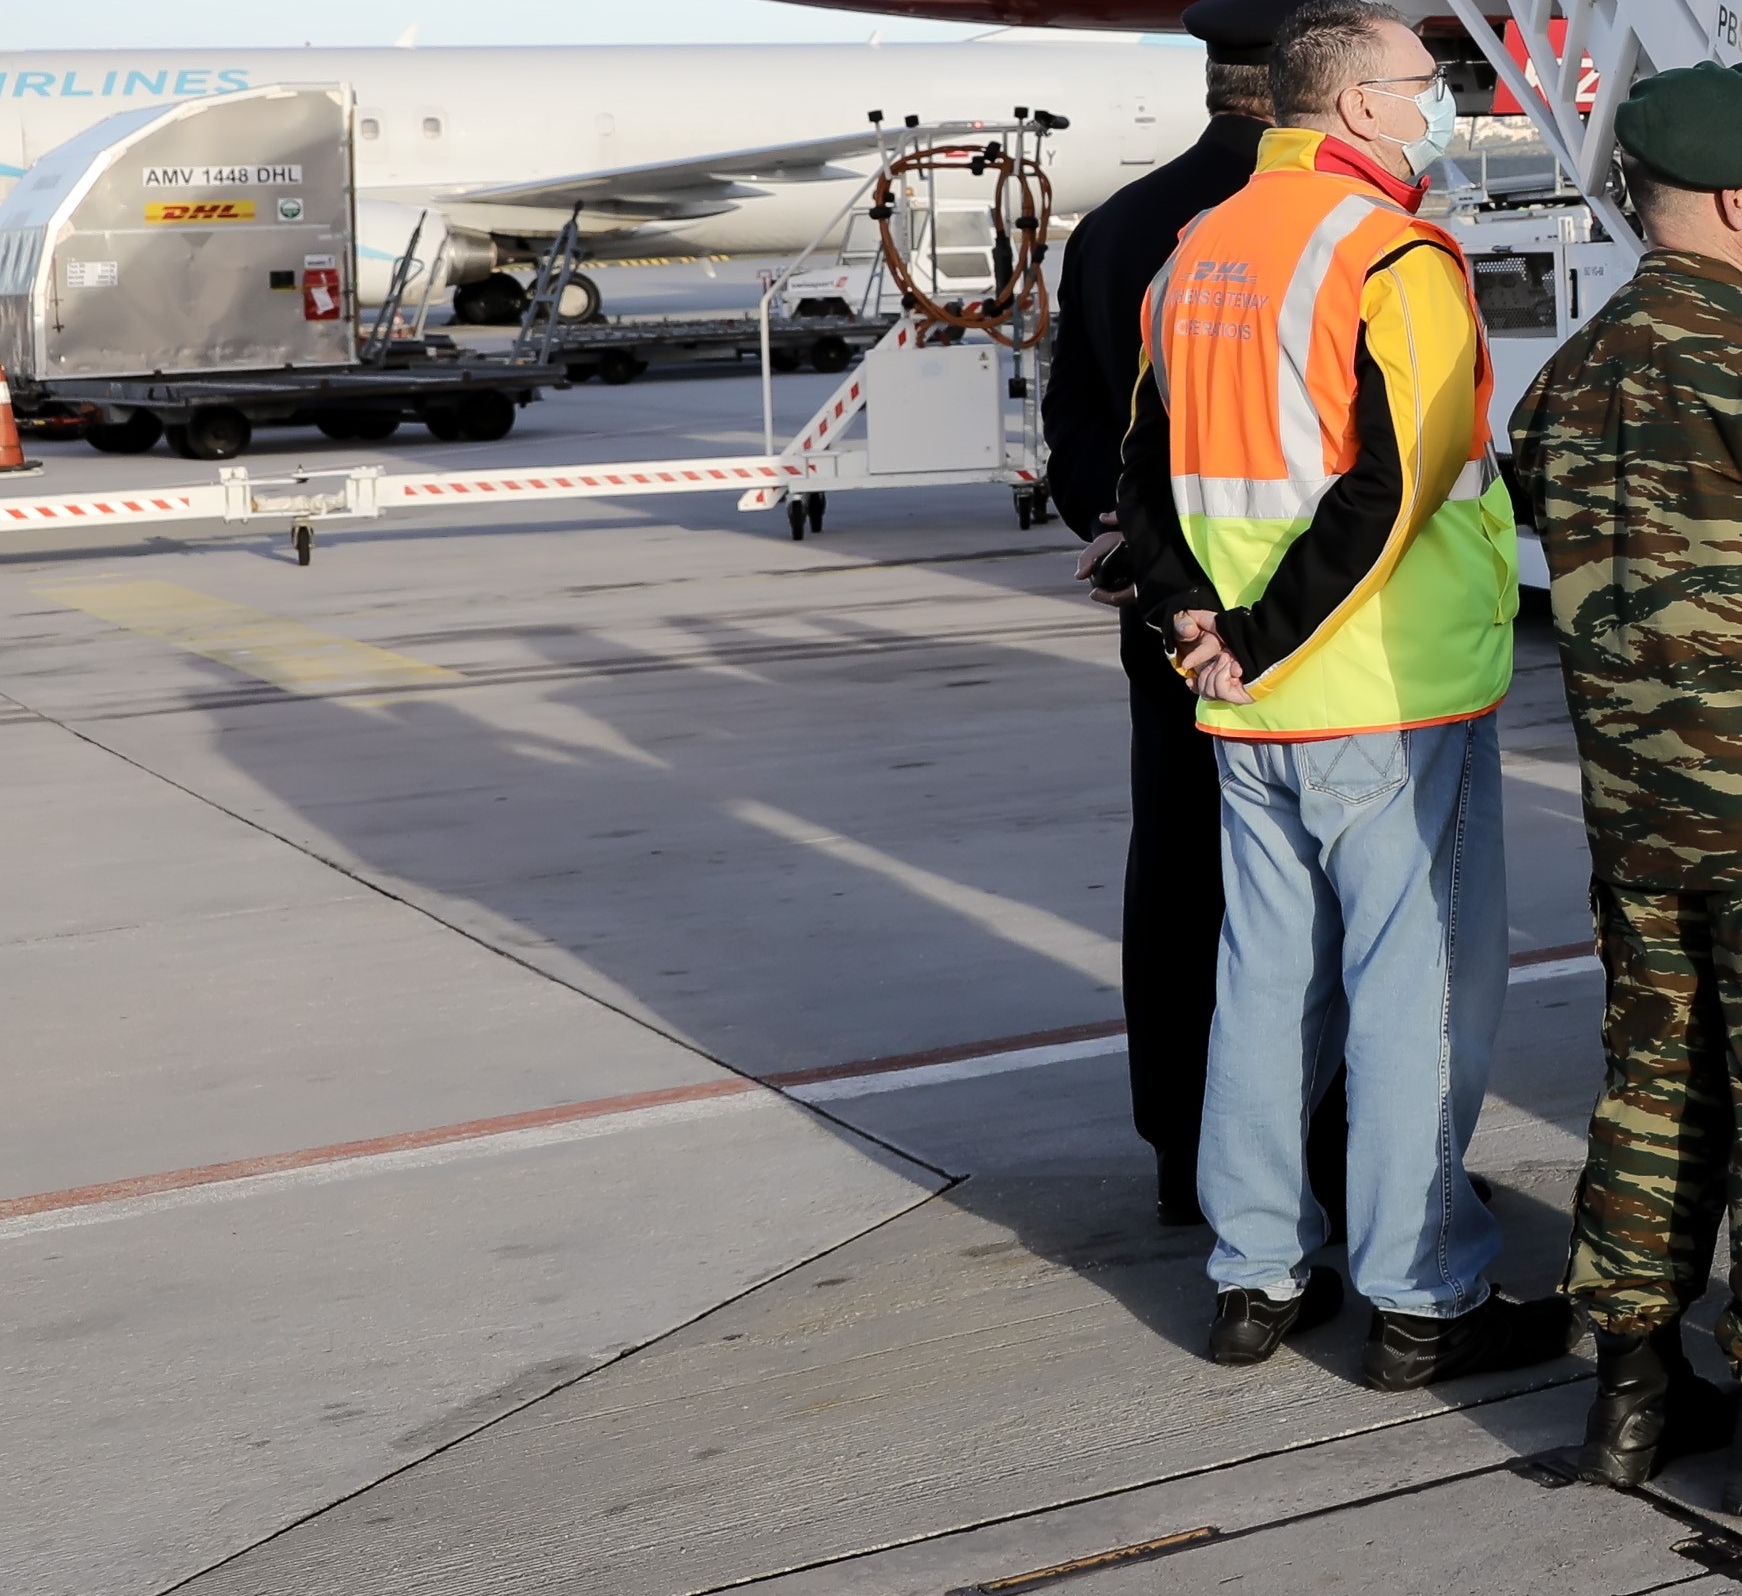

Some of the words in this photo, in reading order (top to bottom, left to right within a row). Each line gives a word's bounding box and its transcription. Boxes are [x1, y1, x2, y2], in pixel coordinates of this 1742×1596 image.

[146, 168, 193, 185] AMV
[204, 168, 248, 184] 1448
[257, 167, 298, 183] DHL
[162, 204, 239, 220] DHL
[1194, 261, 1249, 282] DHL
[1213, 291, 1269, 310] GTEWAY
